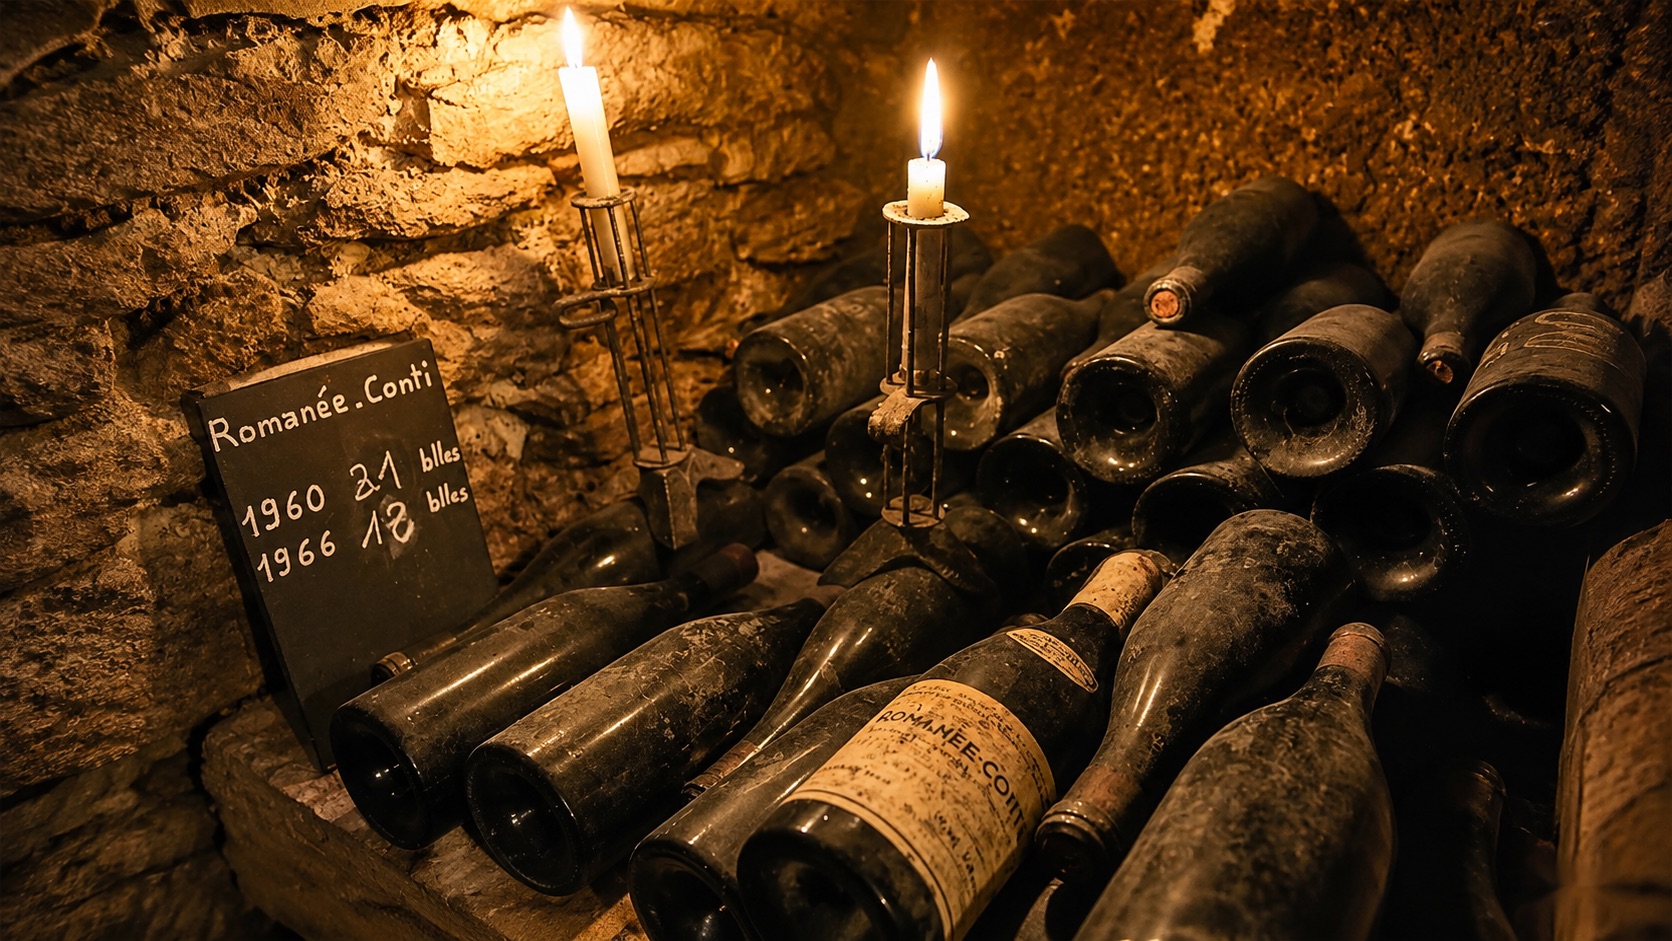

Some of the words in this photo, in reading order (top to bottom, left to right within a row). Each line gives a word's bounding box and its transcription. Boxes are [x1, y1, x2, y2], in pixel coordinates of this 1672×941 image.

[242, 484, 325, 538] 1960
[349, 450, 402, 501] 21
[419, 440, 461, 473] blles
[257, 529, 336, 582] 1966
[426, 482, 468, 513] blles
